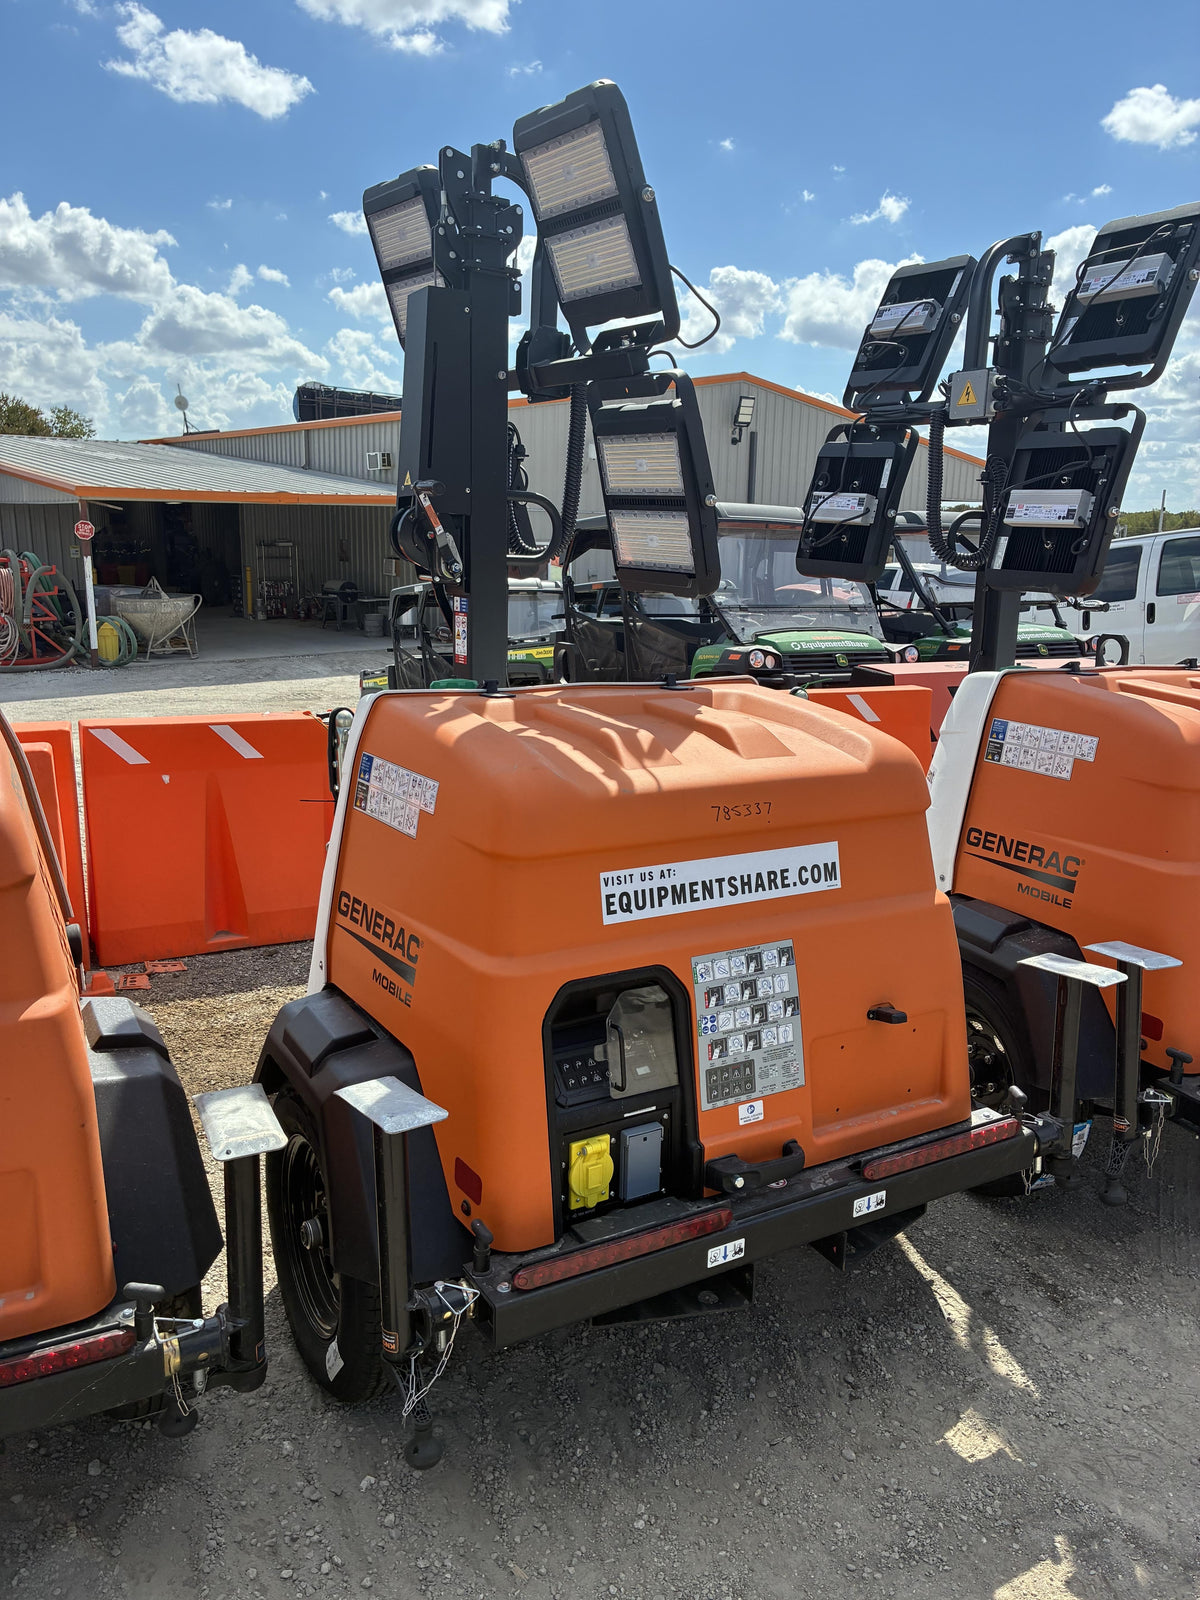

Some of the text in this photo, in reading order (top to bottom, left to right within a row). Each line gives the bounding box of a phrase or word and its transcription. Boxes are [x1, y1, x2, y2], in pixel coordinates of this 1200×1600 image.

[800, 640, 869, 649] EquipmentShare
[711, 802, 771, 822] 785337
[966, 827, 1080, 877] GENERAC
[603, 868, 677, 887] VISIT US AT:
[605, 861, 838, 915] EQUIPMENTSHARE.COM
[1017, 883, 1073, 909] MOBILE
[338, 890, 420, 965] GENERAC
[372, 968, 412, 1008] MOBILE
